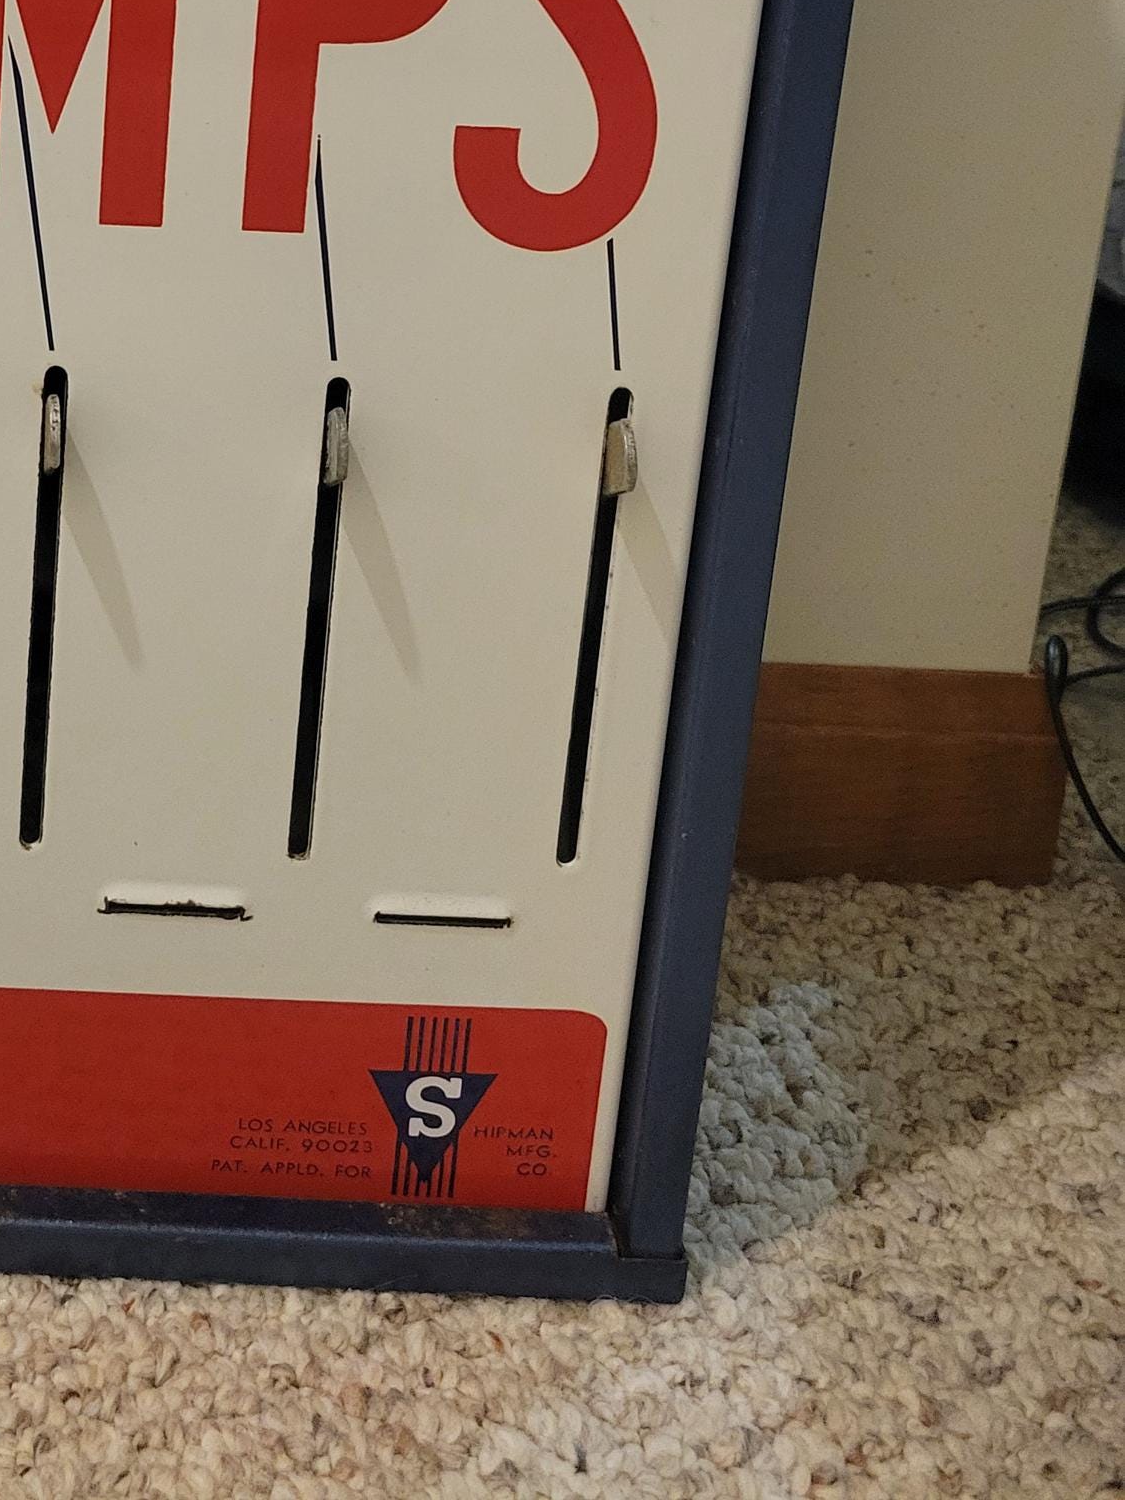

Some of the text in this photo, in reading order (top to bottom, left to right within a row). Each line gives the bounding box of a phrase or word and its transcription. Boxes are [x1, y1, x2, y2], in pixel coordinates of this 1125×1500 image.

[238, 1117, 369, 1136] LOS ANGELES
[335, 1164, 372, 1179] FOR
